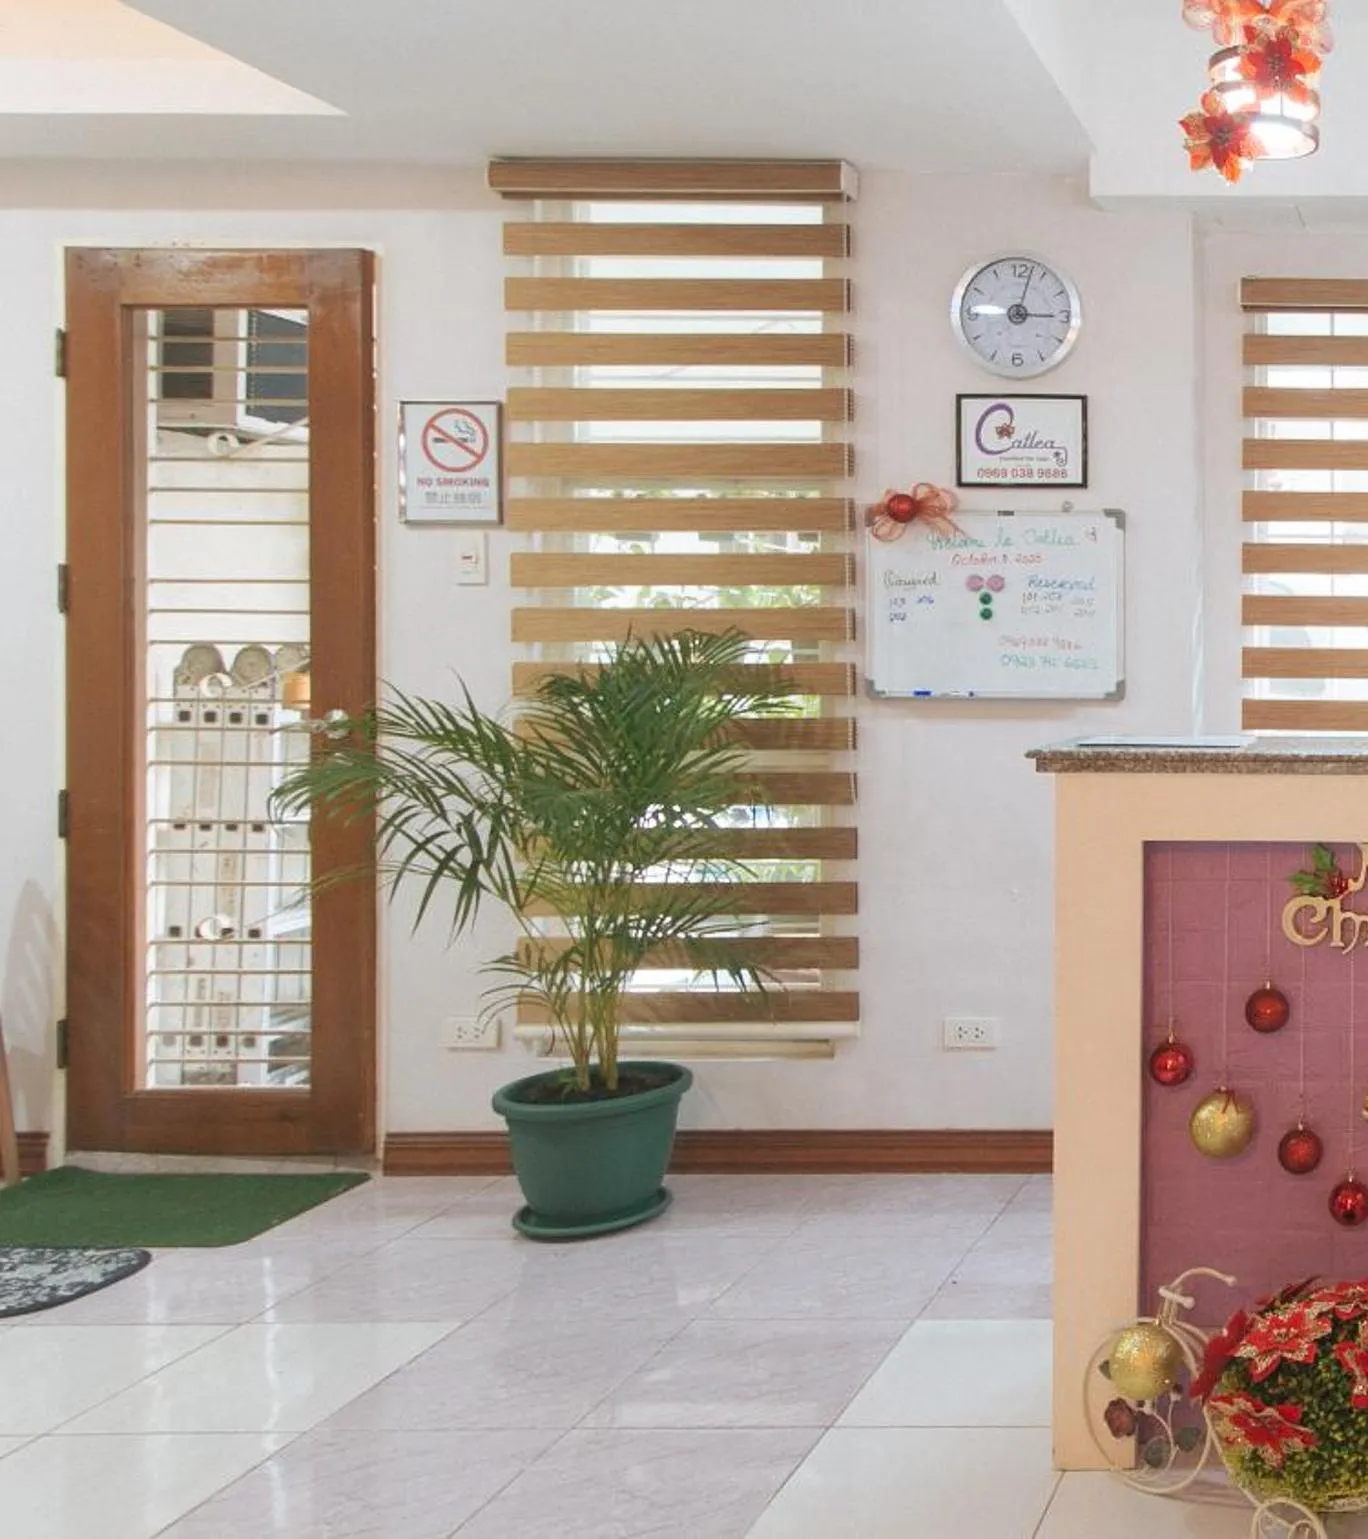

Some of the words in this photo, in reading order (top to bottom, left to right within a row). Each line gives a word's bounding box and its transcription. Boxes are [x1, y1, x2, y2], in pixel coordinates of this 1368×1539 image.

[1011, 264, 1029, 278] 12
[1059, 310, 1071, 324] 3
[1011, 353, 1024, 367] 6
[975, 403, 1057, 455] Catlea
[416, 477, 433, 487] NO
[436, 477, 490, 487] SMOKING
